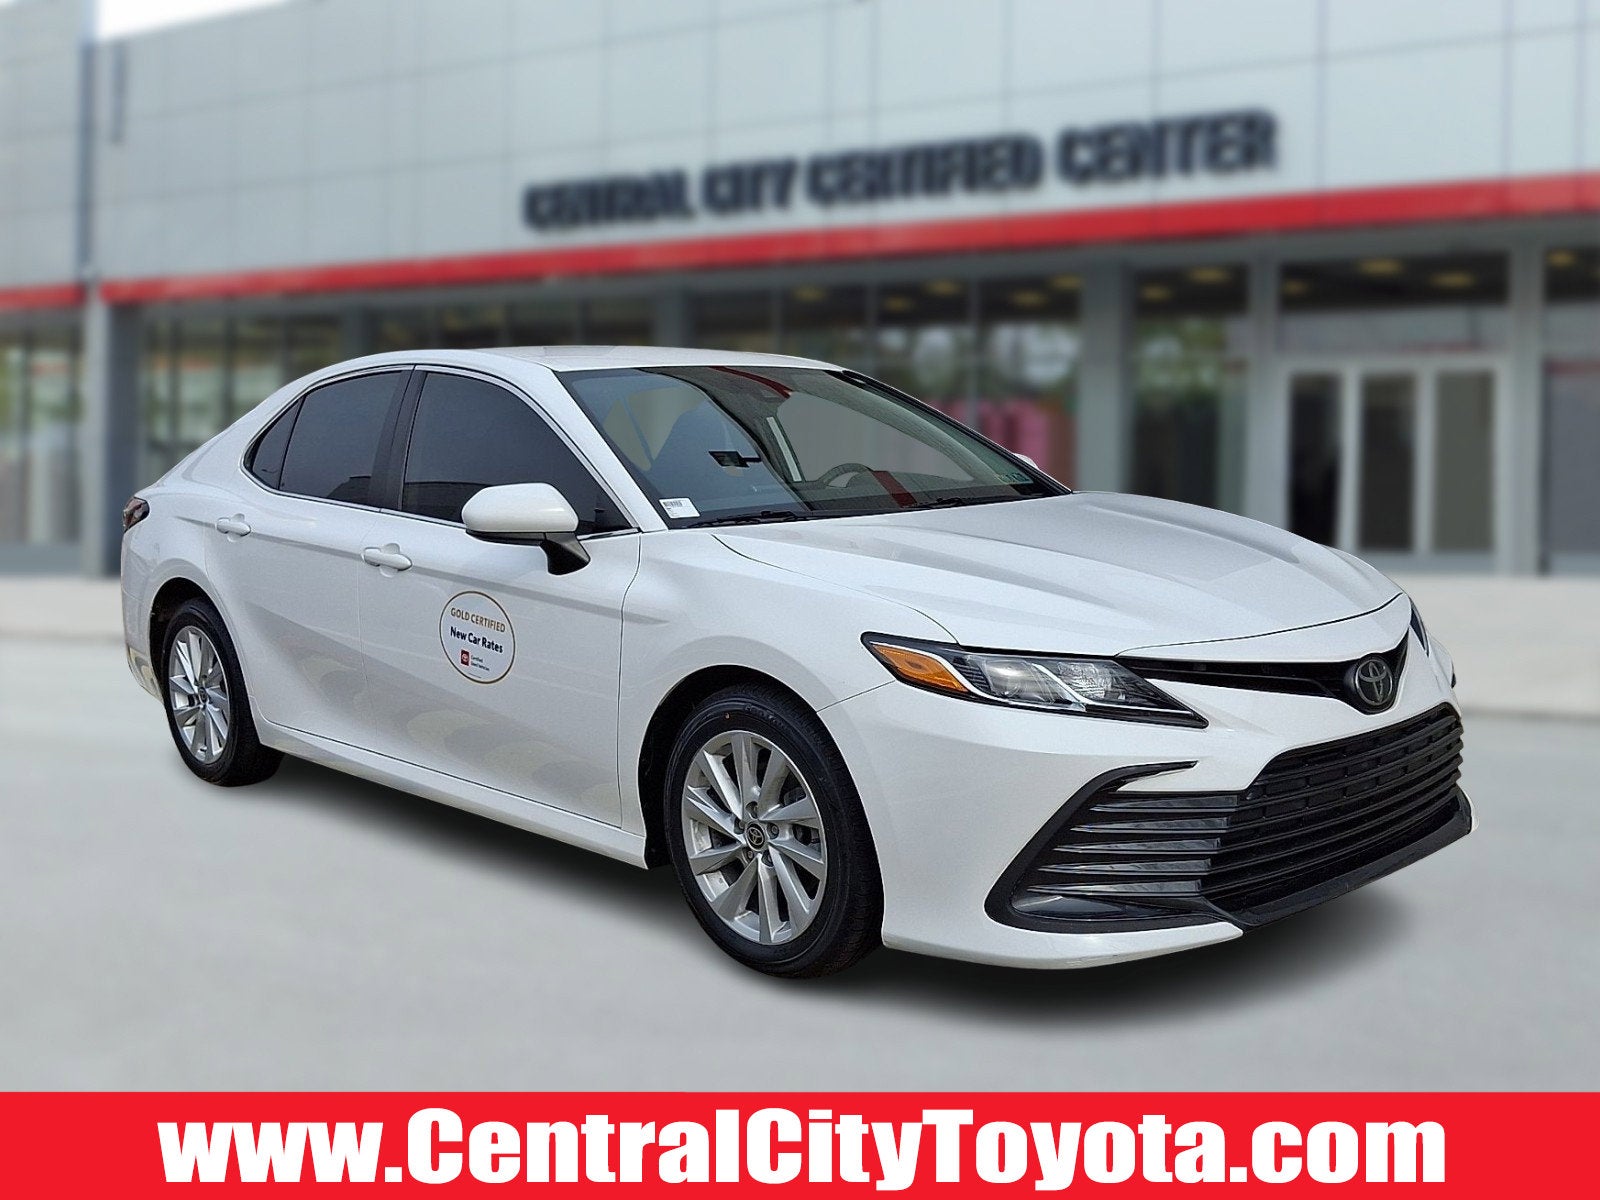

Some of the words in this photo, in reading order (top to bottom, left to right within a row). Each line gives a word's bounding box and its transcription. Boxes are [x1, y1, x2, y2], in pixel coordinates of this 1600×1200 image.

[704, 157, 797, 214] CITY
[1057, 108, 1276, 186] CENTER
[451, 608, 470, 621] GOLD
[471, 614, 505, 632] CERTIFIED
[450, 626, 467, 641] New
[468, 632, 481, 645] Car
[482, 637, 503, 653] Rates
